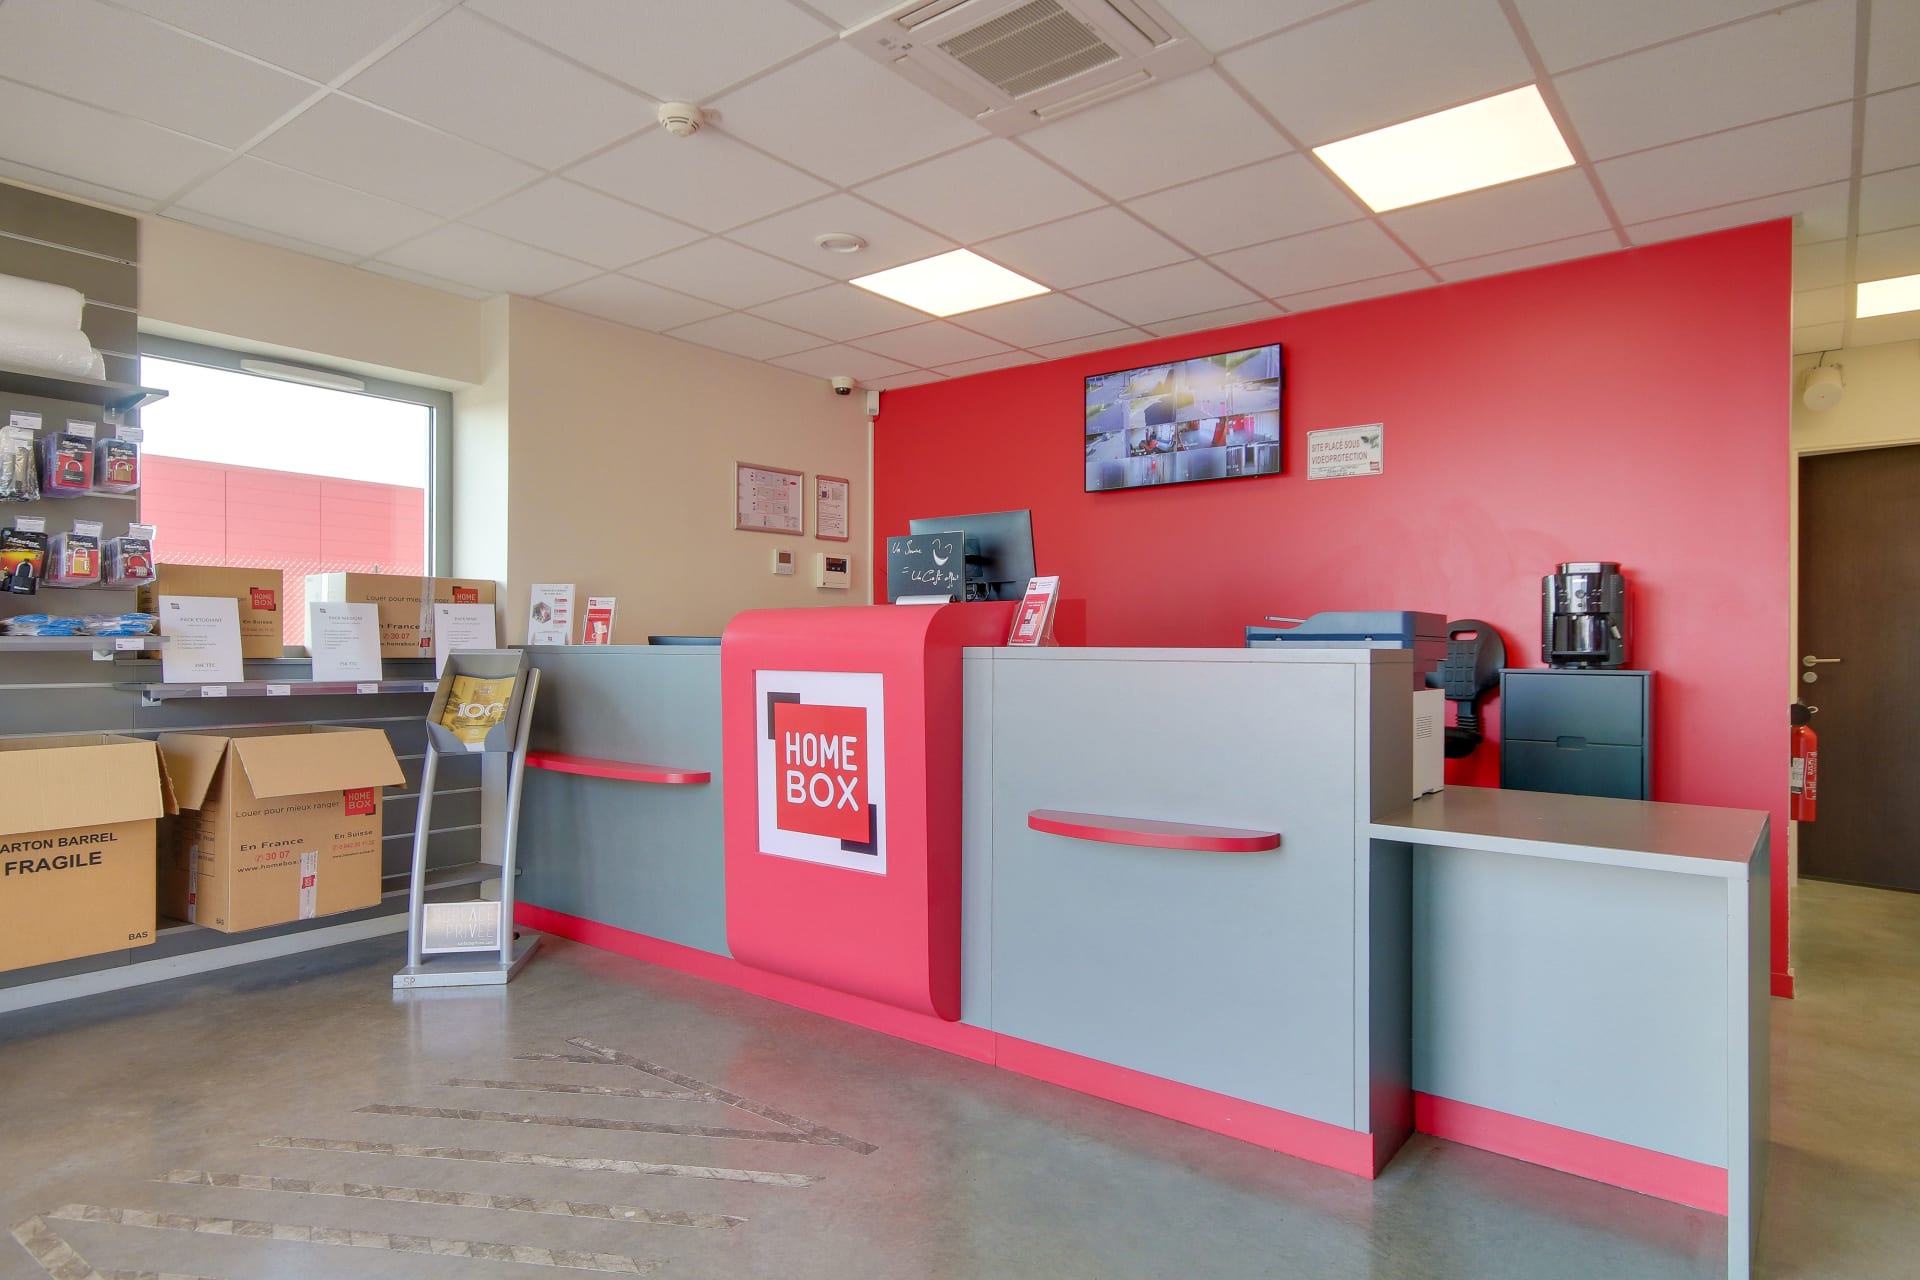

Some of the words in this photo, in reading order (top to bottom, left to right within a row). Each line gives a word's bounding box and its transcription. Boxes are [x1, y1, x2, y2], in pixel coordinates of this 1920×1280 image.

[1311, 443, 1324, 453] SITE
[1344, 439, 1360, 449] SOUS
[785, 731, 858, 771] HOME
[348, 791, 372, 800] HOME
[786, 769, 860, 812] BOX
[235, 810, 261, 818] Louer
[264, 808, 285, 816] pour
[286, 804, 312, 813] mieux
[313, 801, 341, 810] ranger
[349, 800, 372, 810] BOX
[347, 829, 373, 838] Suisse
[0, 838, 53, 854] ARTON
[58, 832, 118, 847] BARREL
[241, 844, 257, 852] En
[261, 837, 304, 848] France
[265, 852, 277, 861] 30
[279, 850, 290, 859] 07
[4, 850, 103, 876] FRAGILE
[128, 931, 149, 940] BAS
